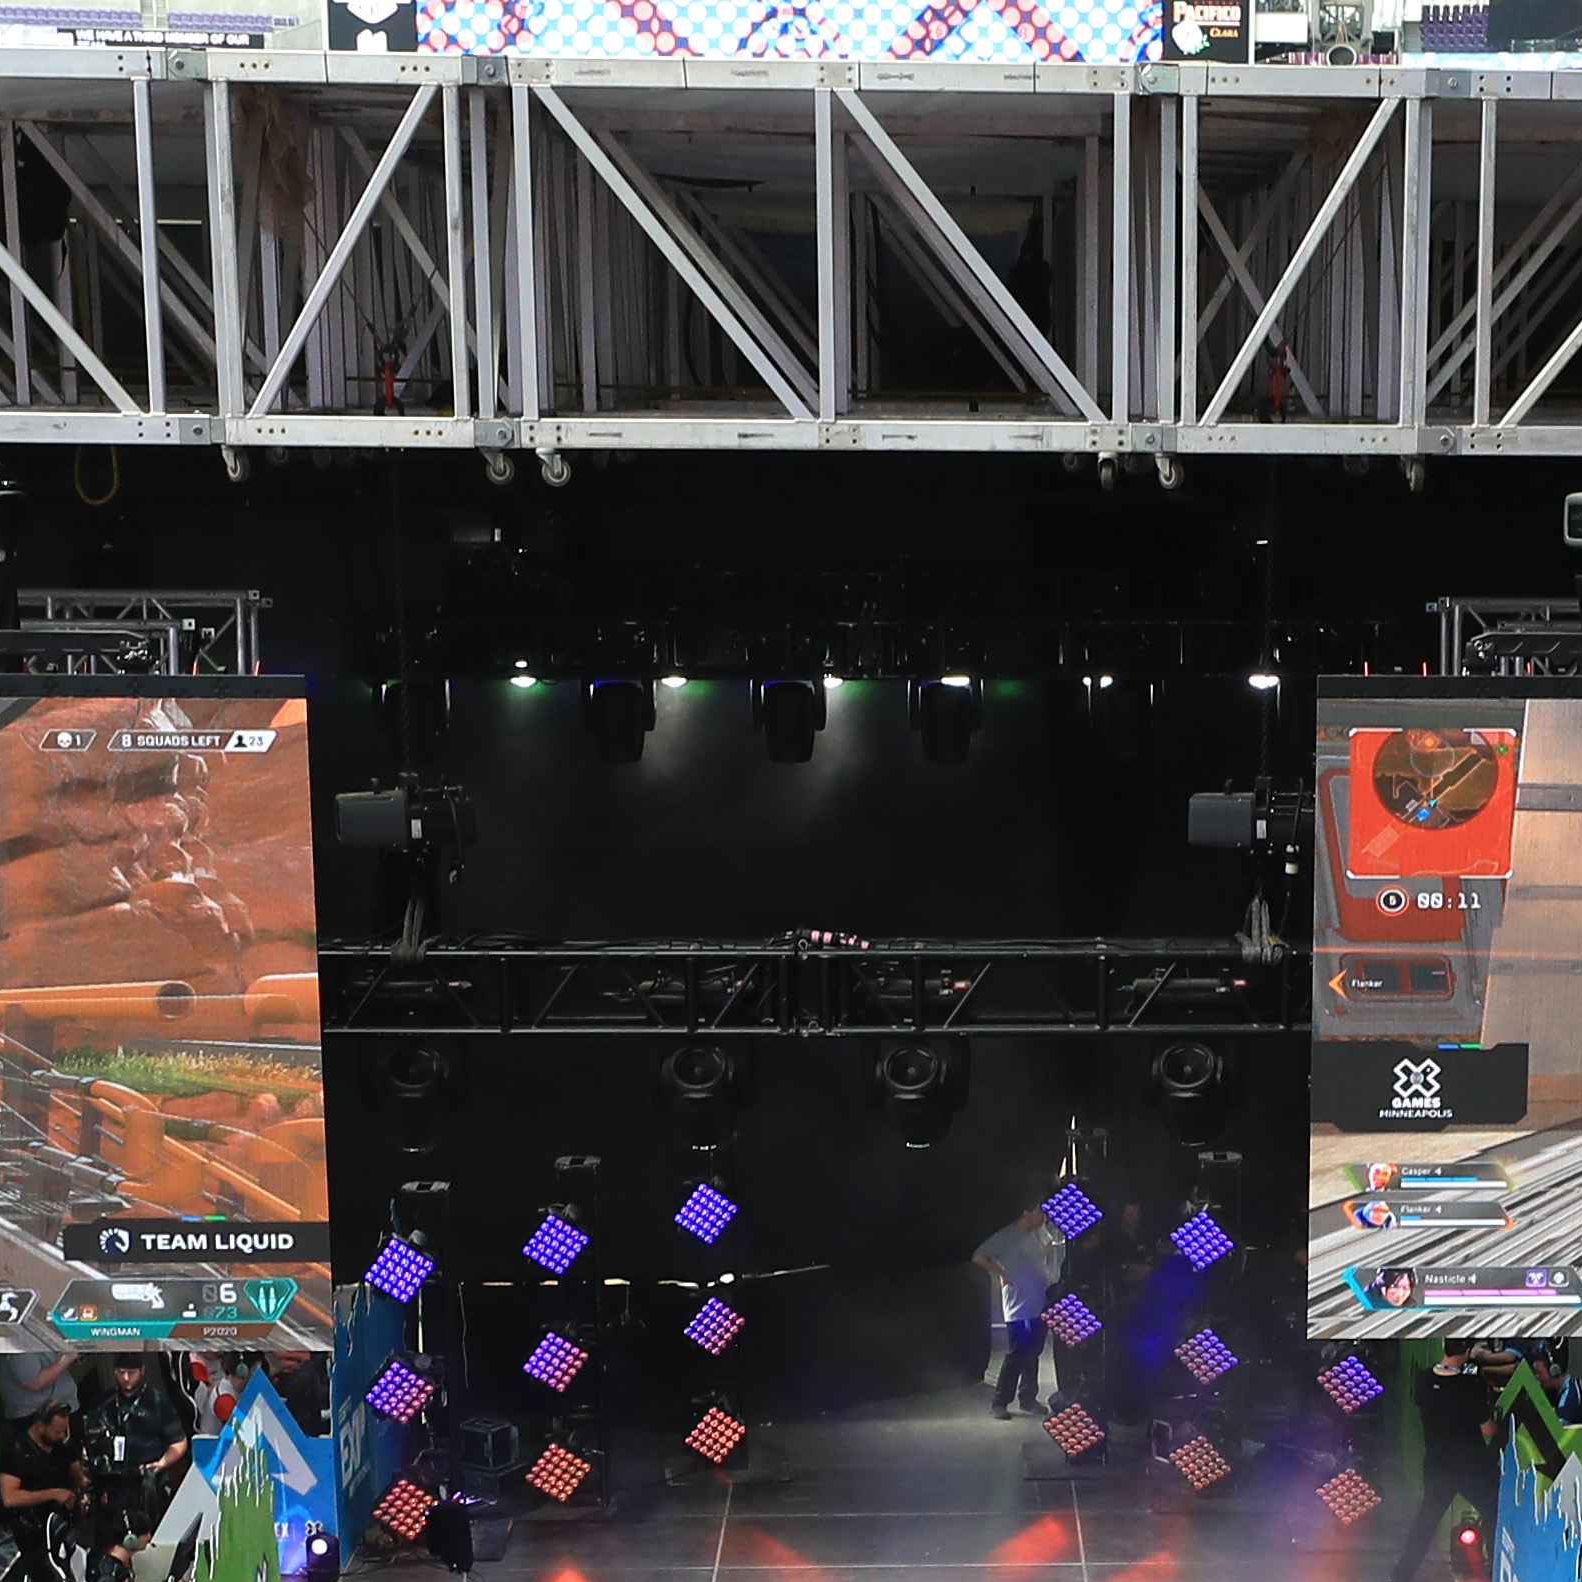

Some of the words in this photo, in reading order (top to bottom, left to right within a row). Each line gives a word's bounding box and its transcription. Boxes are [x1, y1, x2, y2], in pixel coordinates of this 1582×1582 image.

[1173, 1, 1241, 22] PACIFICO
[76, 29, 93, 40] WE
[96, 30, 122, 41] HAVE
[132, 31, 163, 43] THIRD
[165, 32, 209, 44] MEMBER
[211, 34, 225, 45] OF
[227, 34, 250, 46] OUR
[137, 735, 189, 747] SQUADS
[191, 735, 221, 747] LEFT
[1391, 1097, 1441, 1109] GAMES
[1379, 1108, 1453, 1119] MINNEAPOLIS
[141, 1233, 207, 1250] TEAM
[215, 1233, 295, 1254] LIQUID
[89, 1326, 141, 1337] WINGMAN
[203, 1326, 237, 1337] P2020
[274, 1522, 289, 1538] EX
